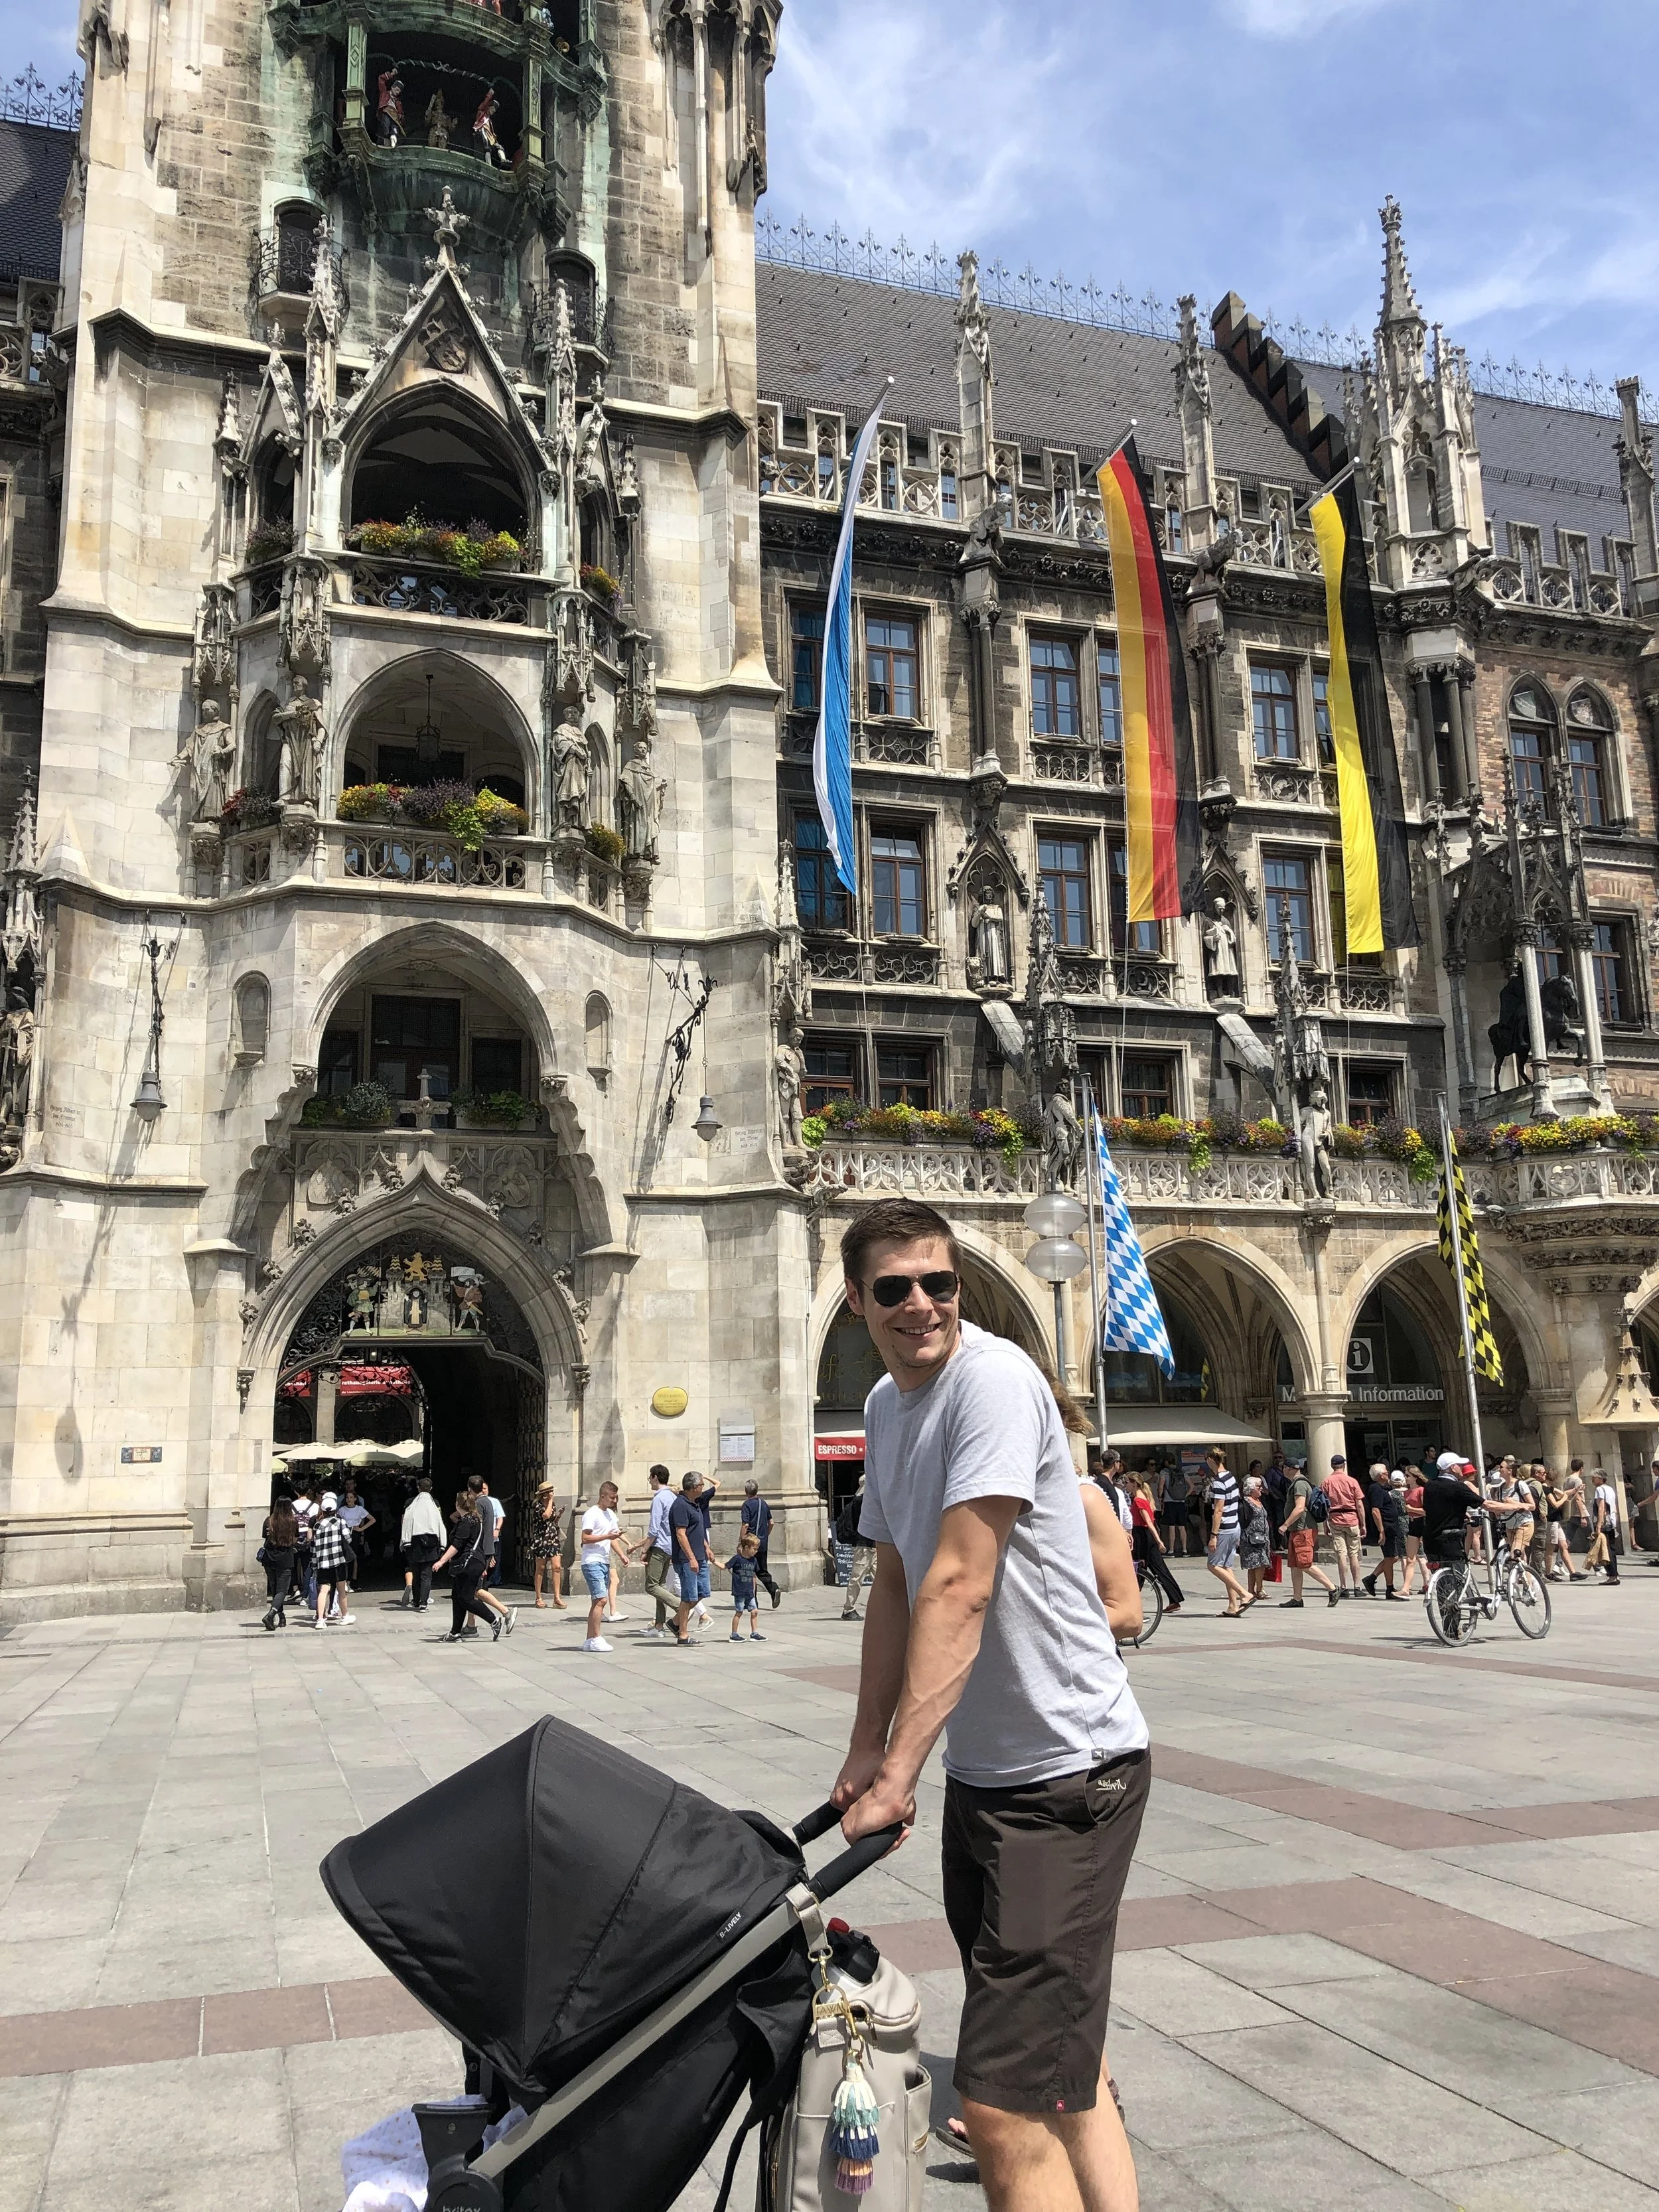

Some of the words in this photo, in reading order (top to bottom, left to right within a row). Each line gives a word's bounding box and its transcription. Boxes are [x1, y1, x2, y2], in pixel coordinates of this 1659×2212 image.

[1360, 1386, 1444, 1402] Information
[818, 1445, 857, 1455] ESPRESSO
[719, 1911, 741, 1938] B-LIVELY
